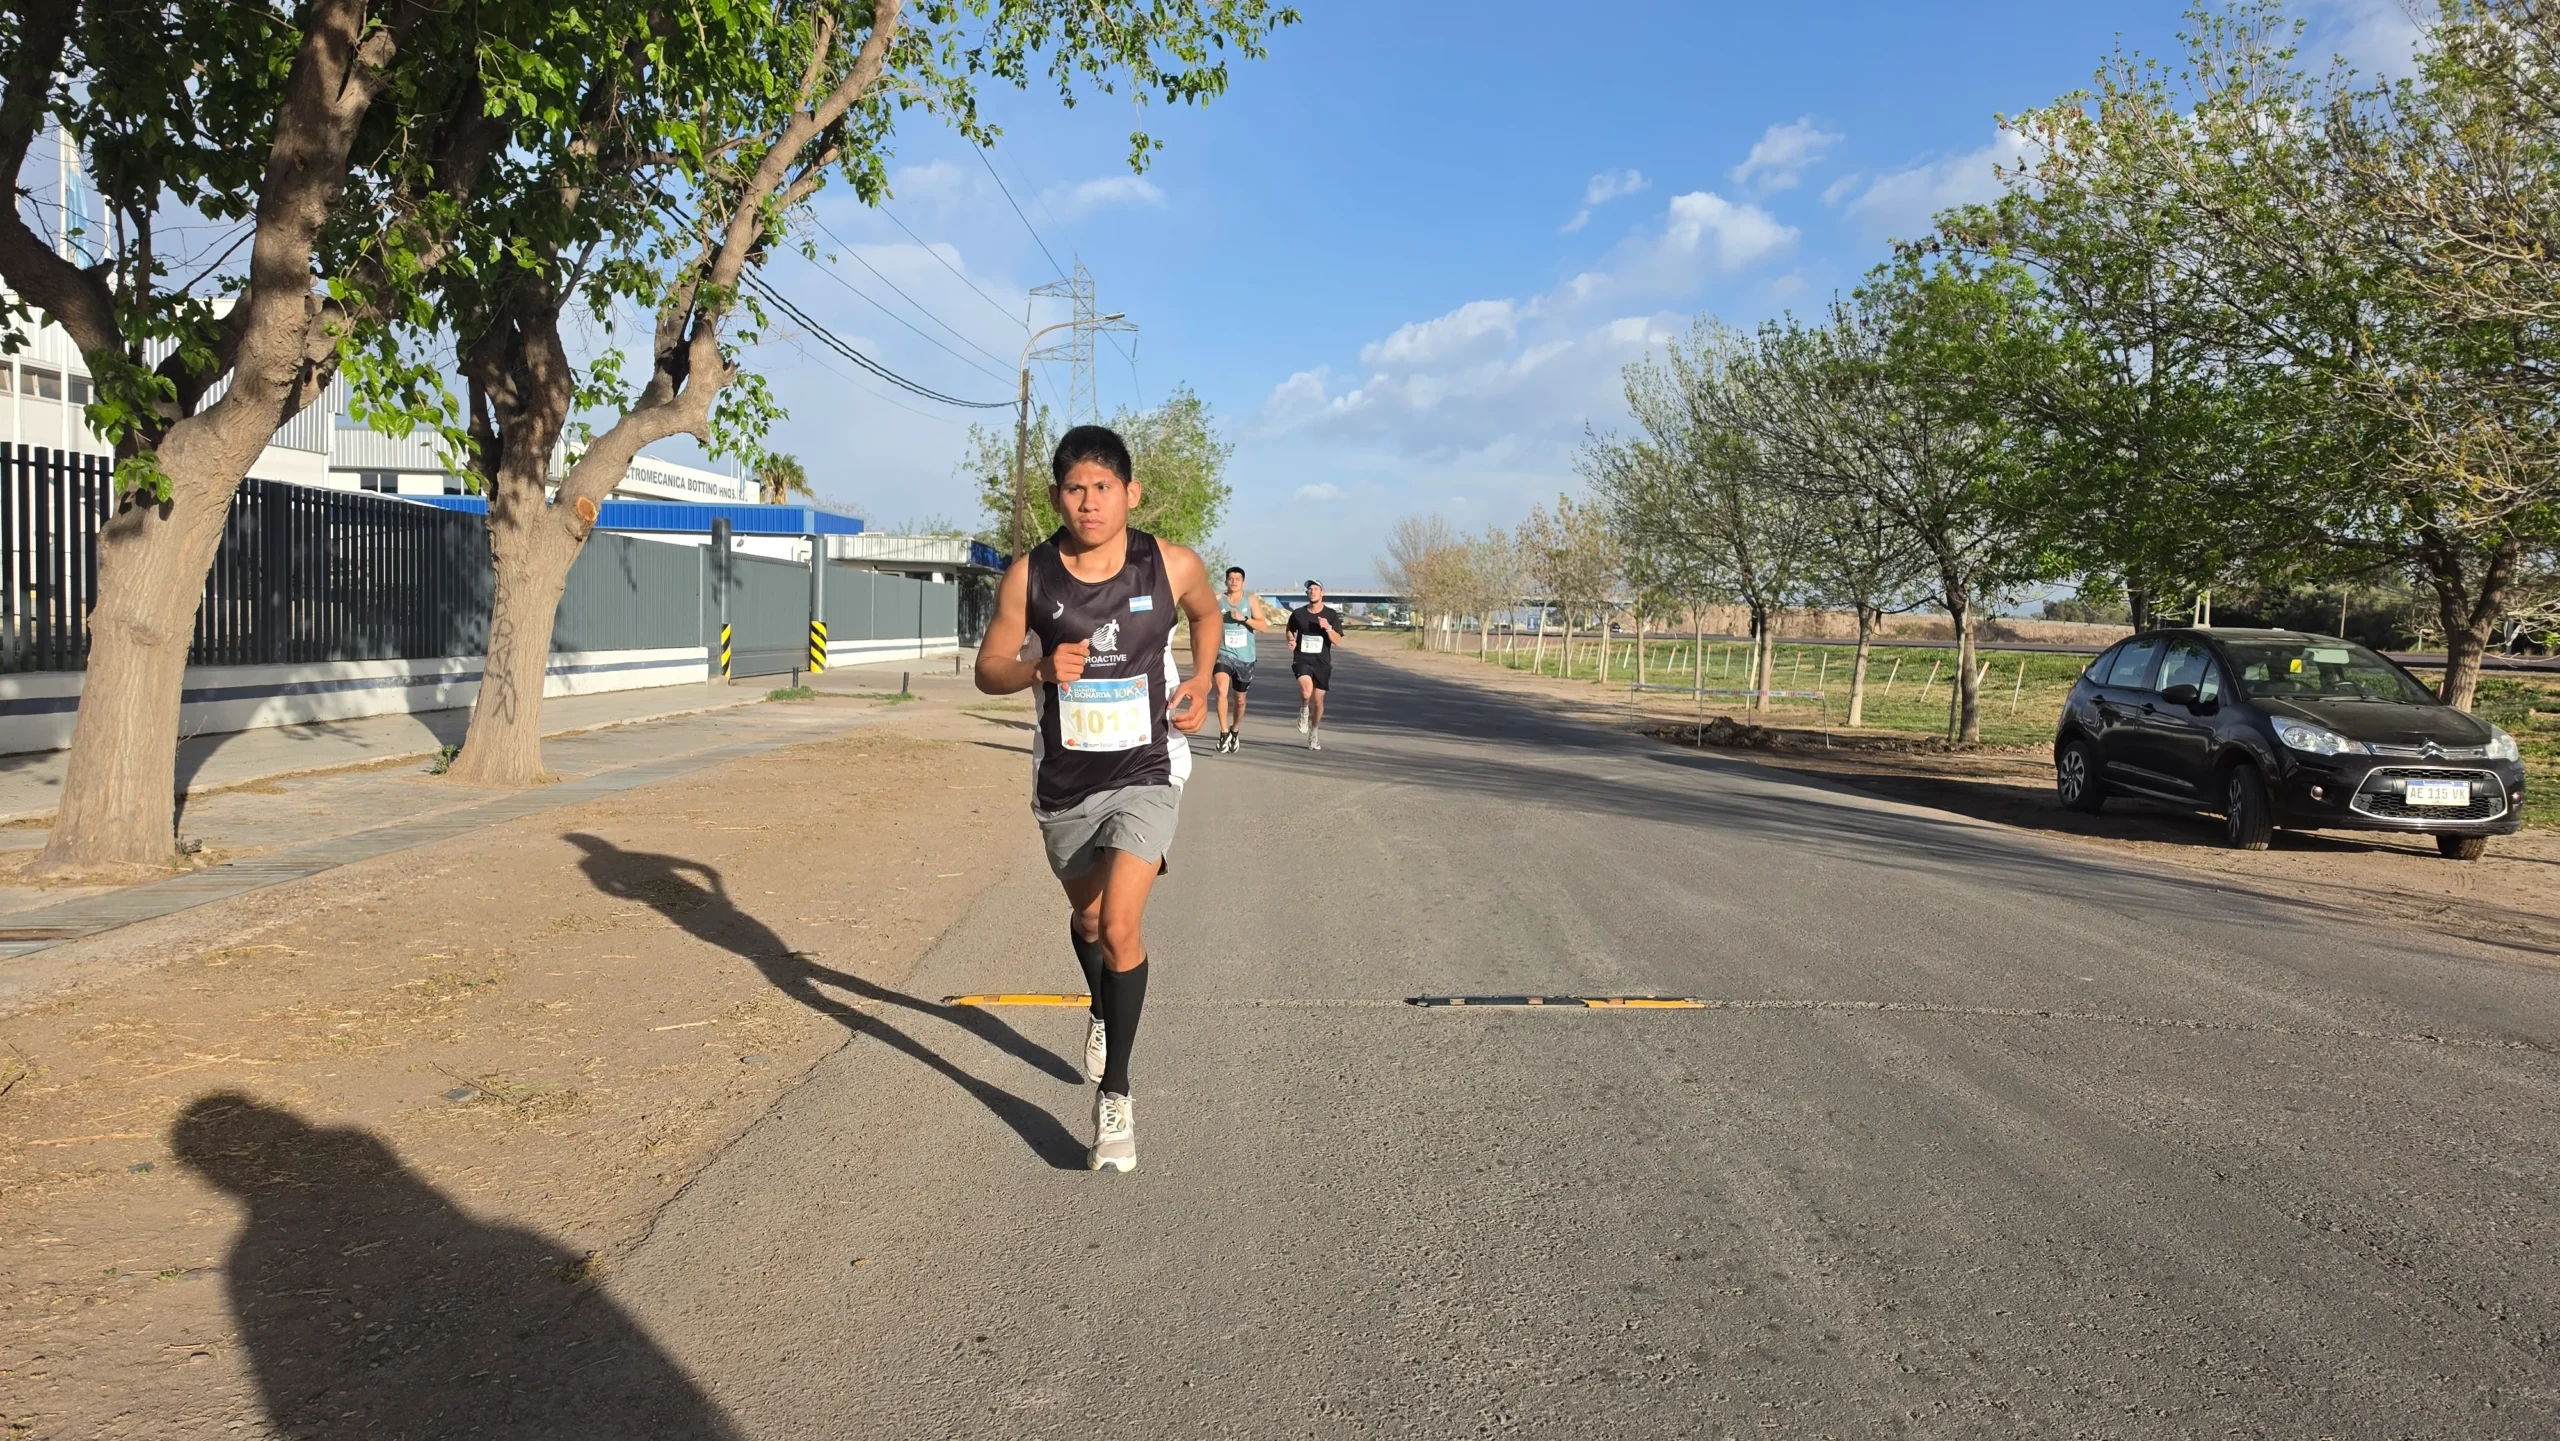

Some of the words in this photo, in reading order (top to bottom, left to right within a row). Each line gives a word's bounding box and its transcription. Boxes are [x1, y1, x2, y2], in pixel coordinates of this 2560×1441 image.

[687, 478, 718, 496] BOTTINO
[1085, 654, 1127, 663] ROACTIVE
[1114, 686, 1134, 698] 10K
[2410, 787, 2423, 799] AE
[2427, 787, 2448, 800] 115
